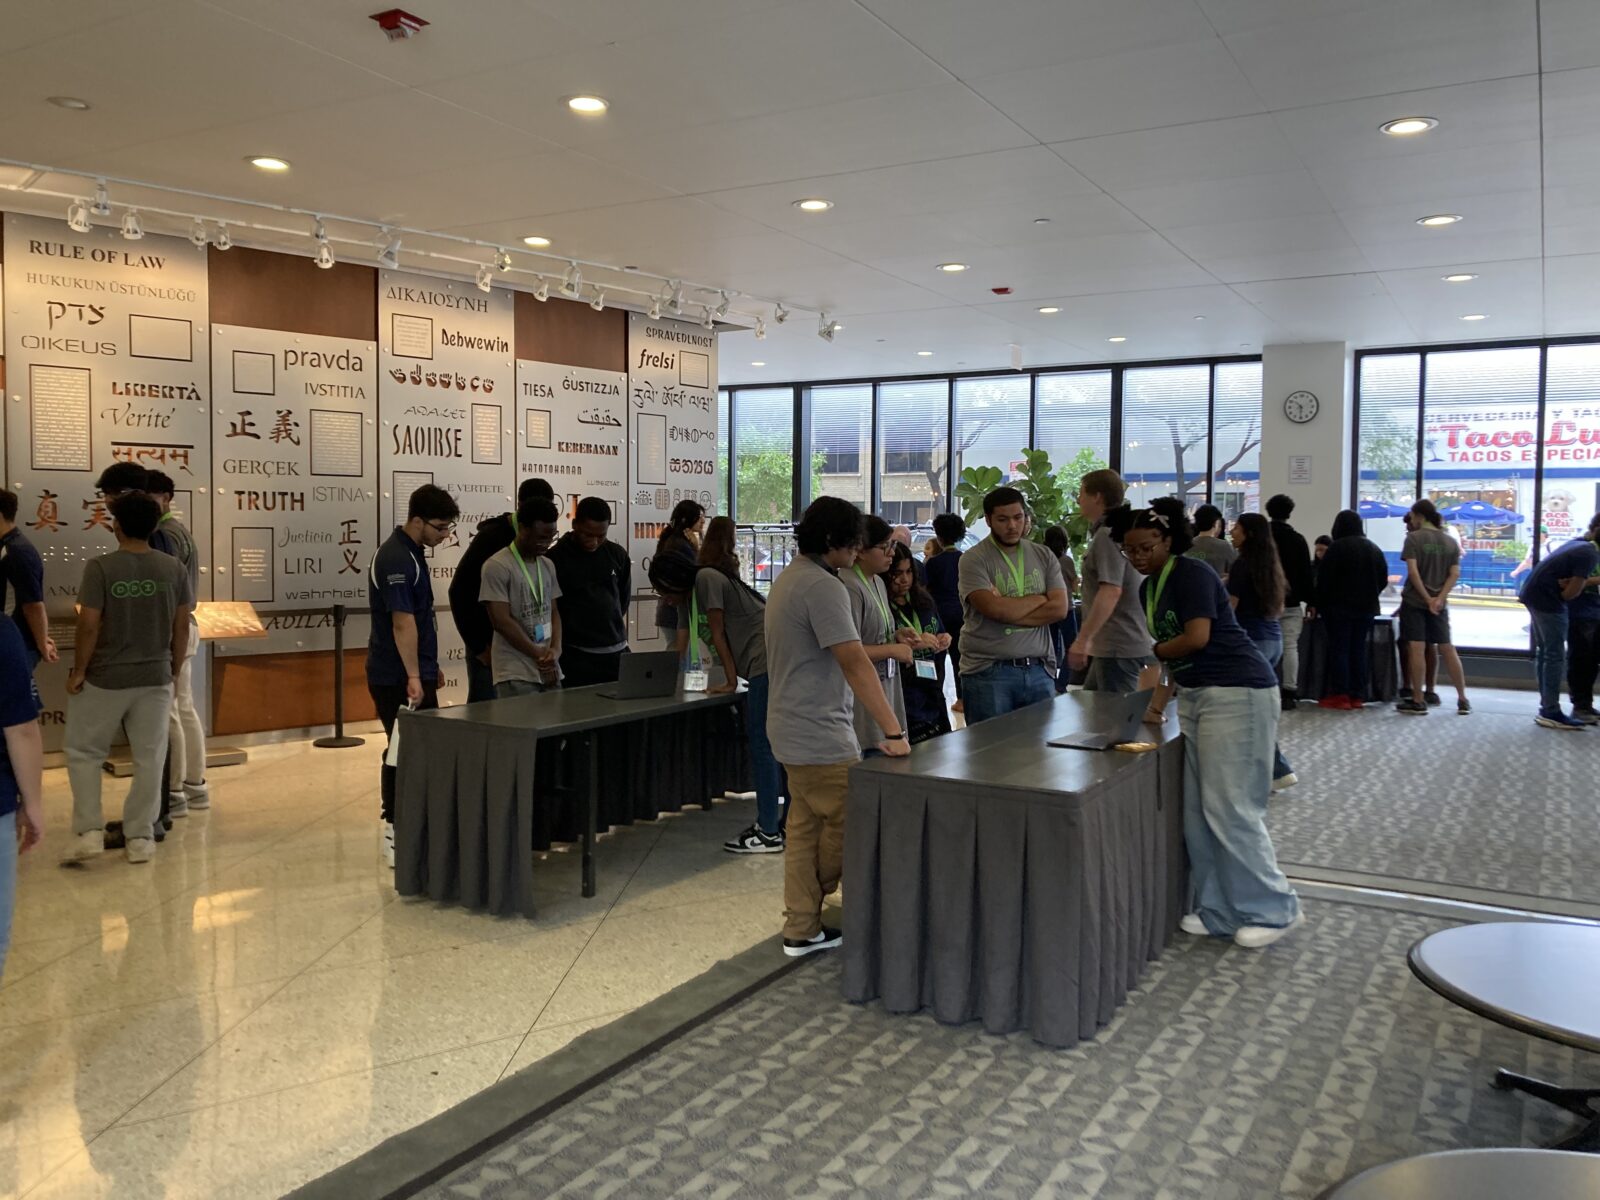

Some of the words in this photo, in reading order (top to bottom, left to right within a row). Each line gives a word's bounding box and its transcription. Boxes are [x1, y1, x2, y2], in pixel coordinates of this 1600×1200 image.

[29, 240, 85, 260] RULE
[91, 248, 118, 264] OF
[124, 253, 166, 270] LAW
[26, 272, 106, 291] HUKUKUN
[110, 281, 196, 302] ÜSTÜNLÜĞÜ
[386, 286, 488, 313] ΔΙΚΑΙΟΣΥΝΗ
[46, 301, 106, 330] צדק
[21, 335, 117, 355] OIKEUS
[441, 328, 509, 353] Debwewin
[645, 326, 713, 348] SPRAVEDLNOST
[284, 349, 363, 372] pravda
[638, 348, 675, 370] frelsi
[112, 382, 201, 401] LIBERTÀ
[304, 382, 366, 399] IVSTITIA
[523, 383, 554, 398] TIESA
[562, 376, 620, 396] ĠUSTIZZJA
[225, 410, 300, 446] 正義
[393, 423, 462, 458] SAOIRSE
[557, 441, 619, 456] KEBEBASAN
[1449, 450, 1512, 462] TACOS
[1521, 448, 1600, 462] EPECIA
[223, 459, 300, 478] GERÇEK
[234, 490, 305, 511] TRUTH
[312, 486, 365, 502] ISTINA
[338, 519, 362, 574] 正义
[284, 558, 322, 574] LIRI
[285, 588, 366, 600] wahrheit
